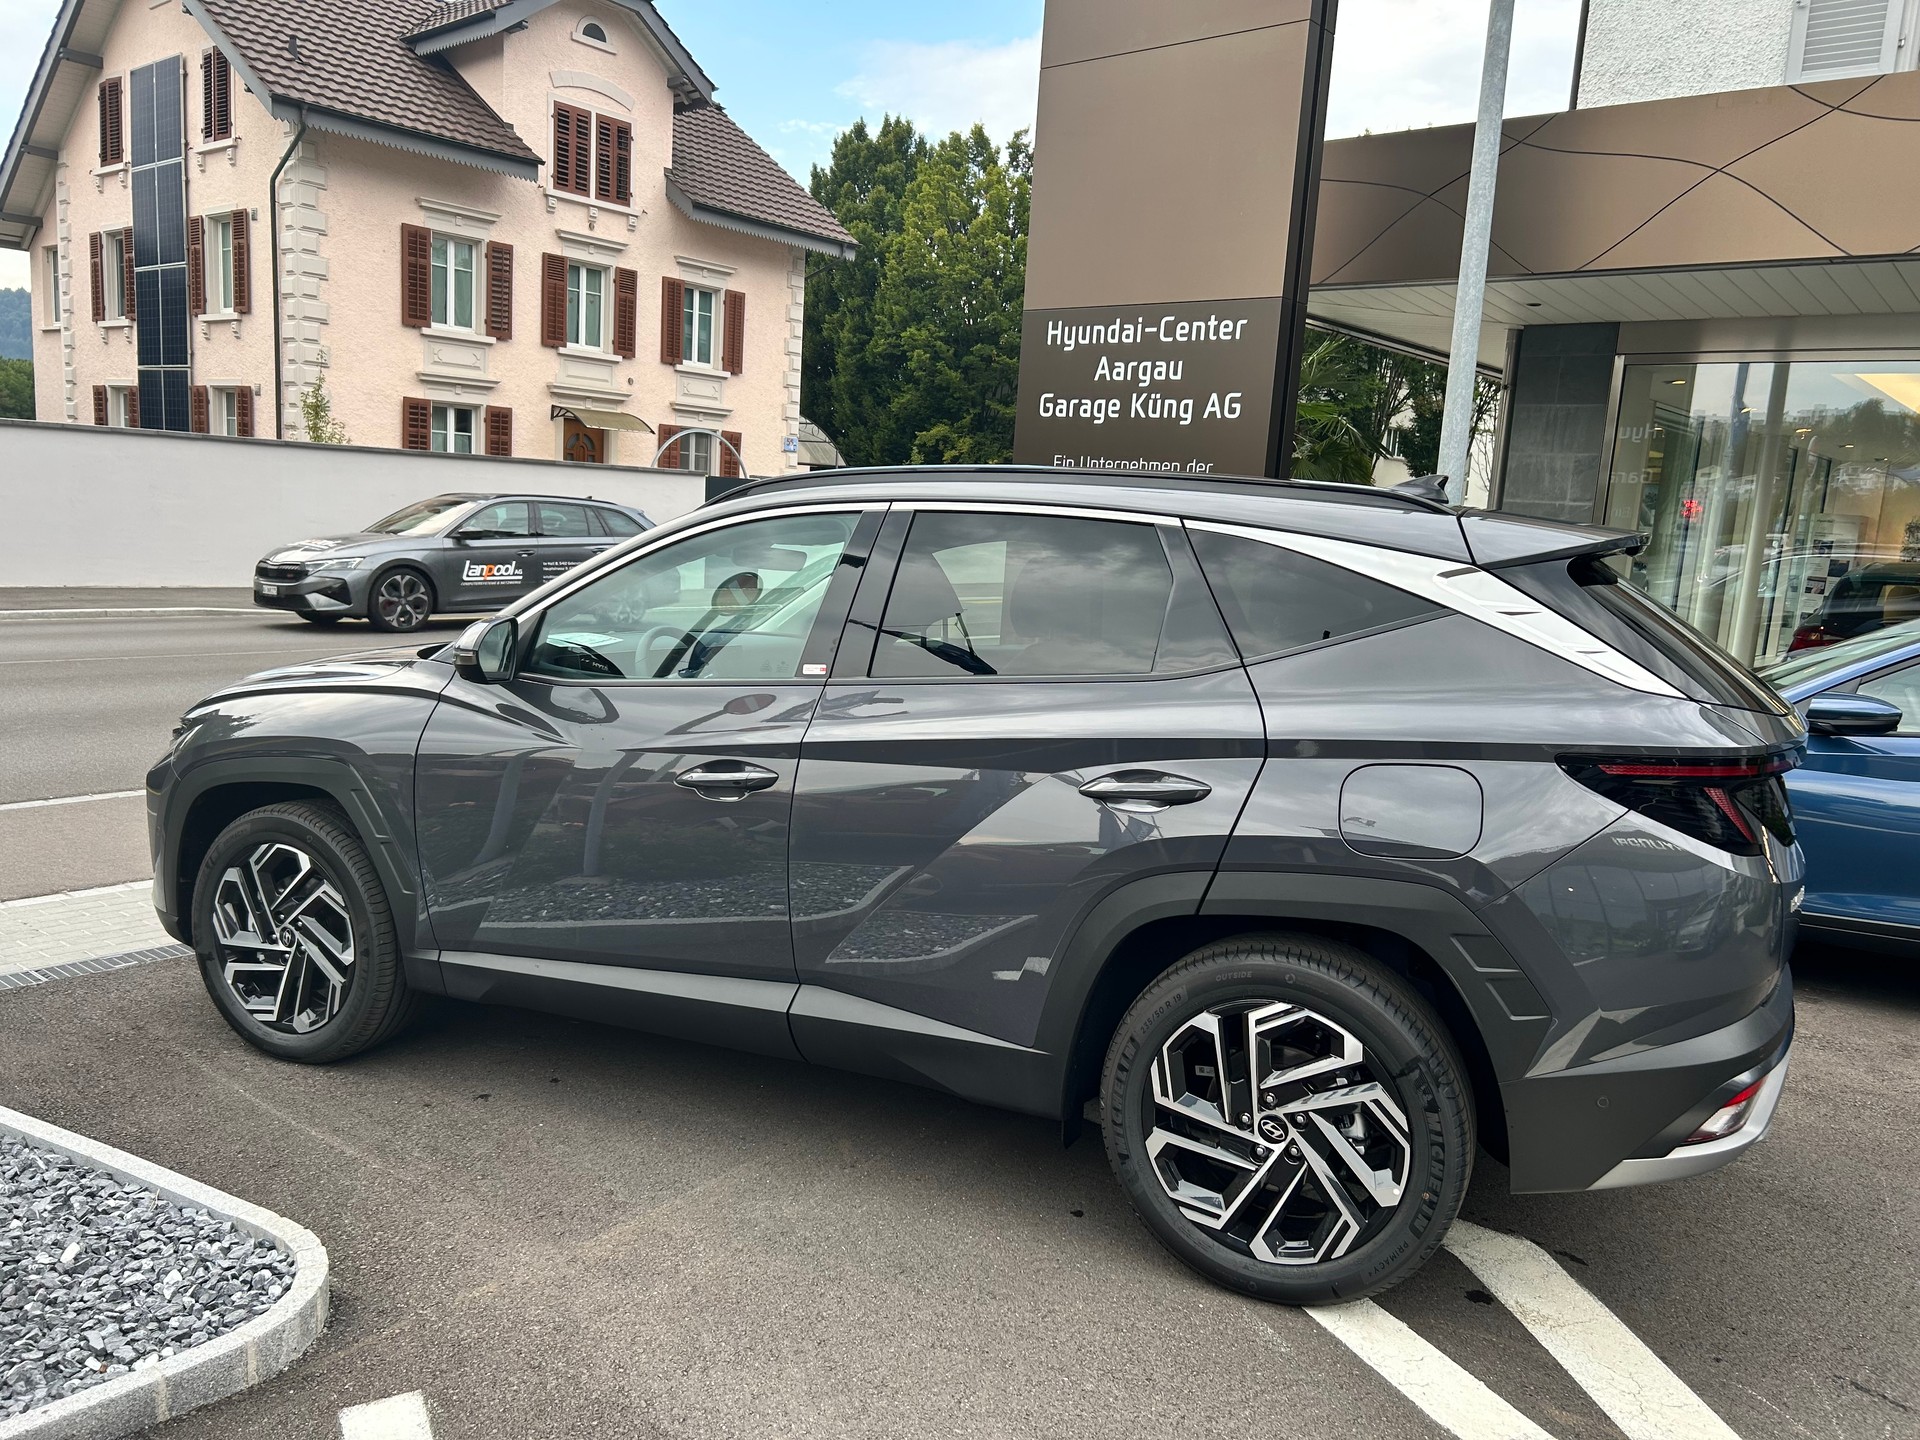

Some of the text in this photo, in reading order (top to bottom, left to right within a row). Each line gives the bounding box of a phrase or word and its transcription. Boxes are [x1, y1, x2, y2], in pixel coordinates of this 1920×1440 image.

[1047, 314, 1248, 351] Hyundai-Center
[1093, 356, 1184, 387] Aargau
[1039, 392, 1242, 425] Garage Küng AG
[1053, 455, 1214, 474] Ein Unternehmen der
[462, 560, 518, 580] Lanpool
[1215, 971, 1253, 982] OUTSIDE
[1140, 993, 1182, 1035] 235/50 R 19
[1412, 1111, 1445, 1233] MICHELIN
[1373, 1240, 1409, 1275] PRIMACY
